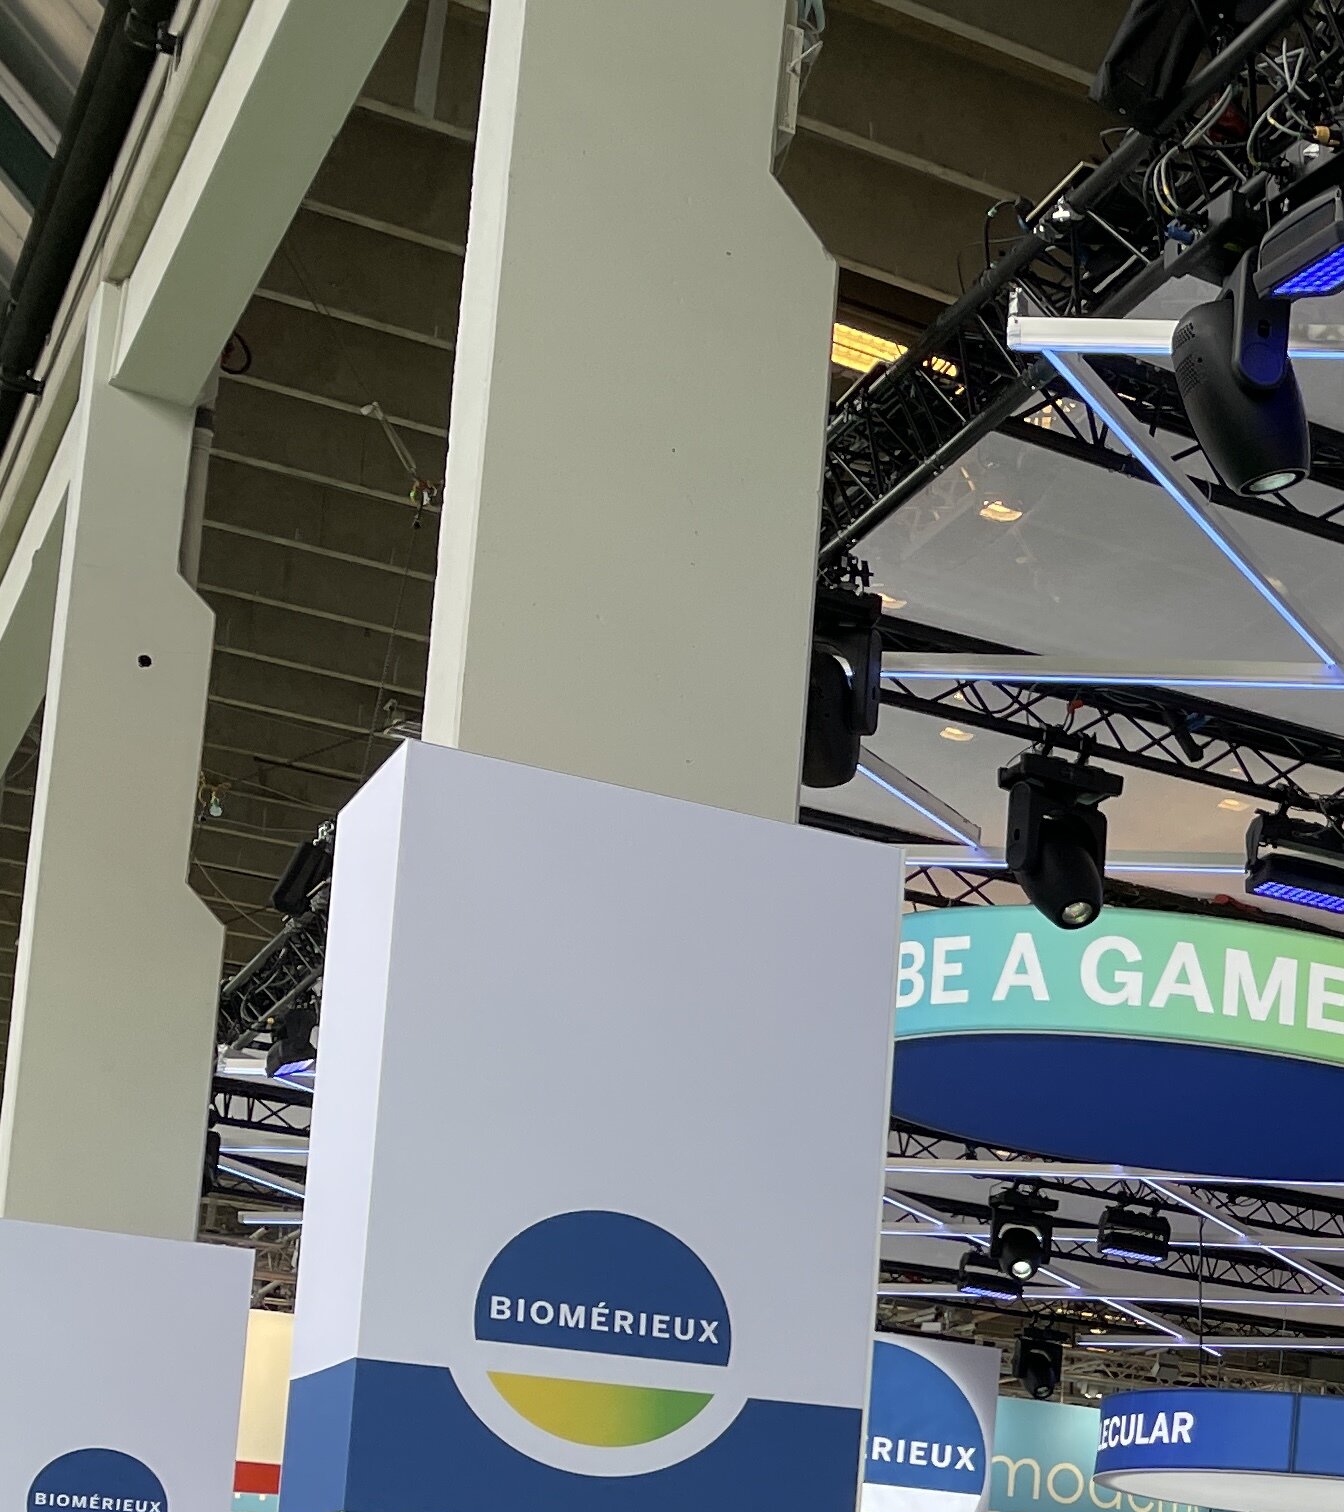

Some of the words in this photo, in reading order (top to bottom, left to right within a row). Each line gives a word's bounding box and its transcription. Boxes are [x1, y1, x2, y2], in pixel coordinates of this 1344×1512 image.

[896, 935, 970, 1008] BE
[992, 932, 1050, 1001] A
[489, 1295, 720, 1346] BIOMÉRIEUX
[1098, 1412, 1194, 1450] ECULAR
[866, 1436, 976, 1472] RIEUX
